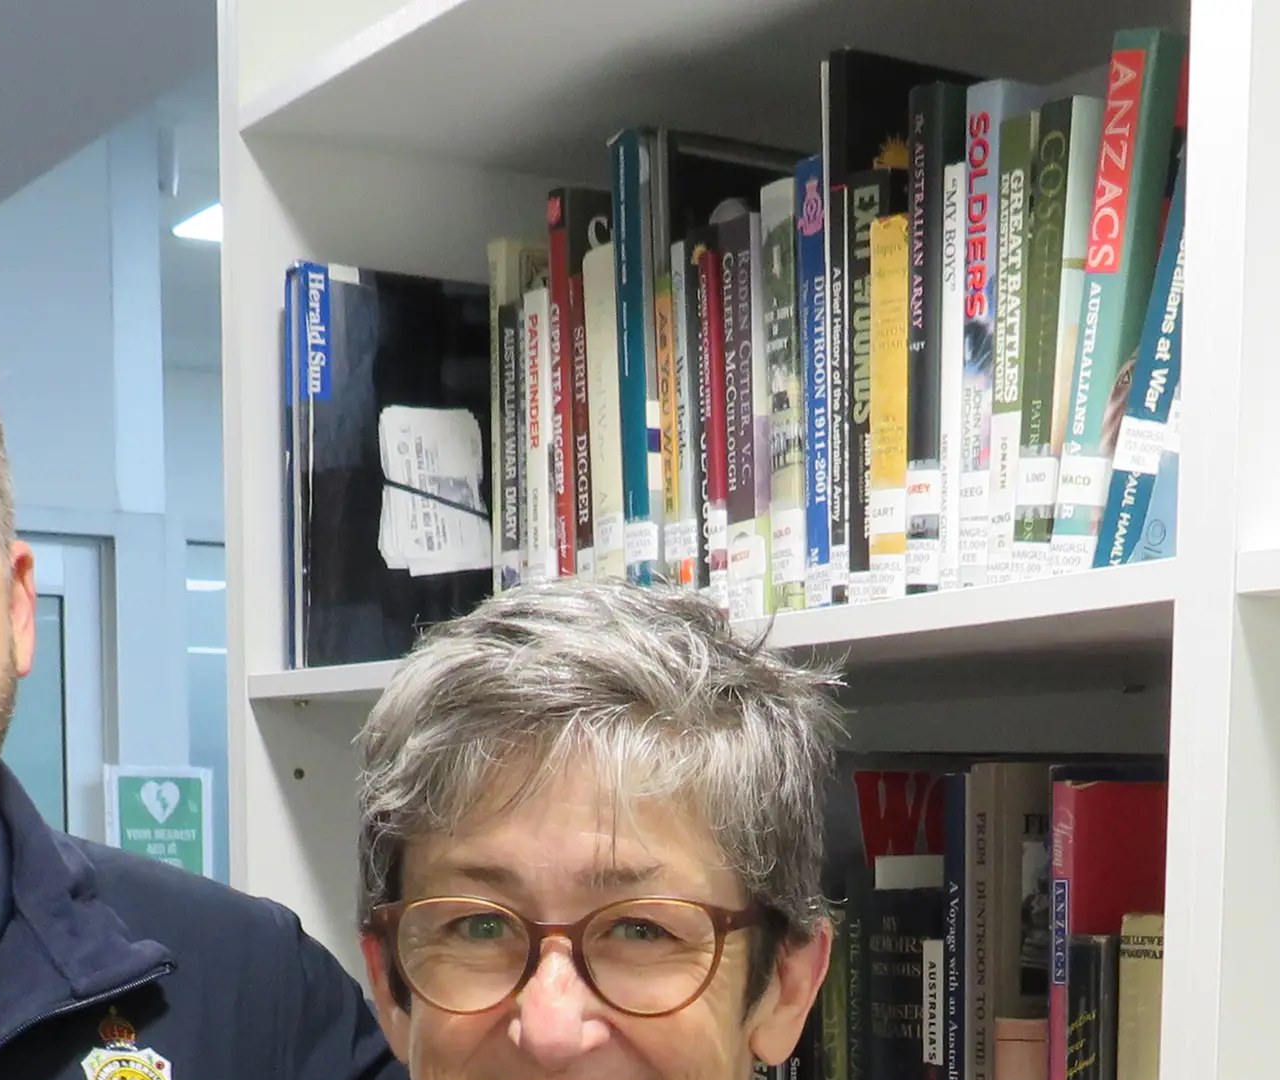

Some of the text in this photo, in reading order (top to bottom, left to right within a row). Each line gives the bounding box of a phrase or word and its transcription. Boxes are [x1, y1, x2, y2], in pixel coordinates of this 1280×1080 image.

[910, 142, 925, 329] AUSTRALIAN ARMY
[965, 110, 991, 320] SOLDIERS
[1072, 60, 1137, 436] ANZACS AUSTRALIANS
[307, 271, 327, 393] Herald Sun
[722, 251, 734, 342] COLLEEN
[1154, 336, 1172, 363] at
[527, 313, 541, 449] PATHFINDER
[571, 326, 591, 526] SPIRIT DIGGER
[812, 275, 827, 505] DUNTROON 1911-2001
[832, 266, 843, 522] A Brief History of the Australian Army
[1143, 367, 1170, 413] War
[505, 434, 519, 541] WAR DIARY
[946, 897, 959, 952] Voyage
[948, 881, 959, 893] A
[948, 957, 959, 992] with
[948, 997, 957, 1016] an
